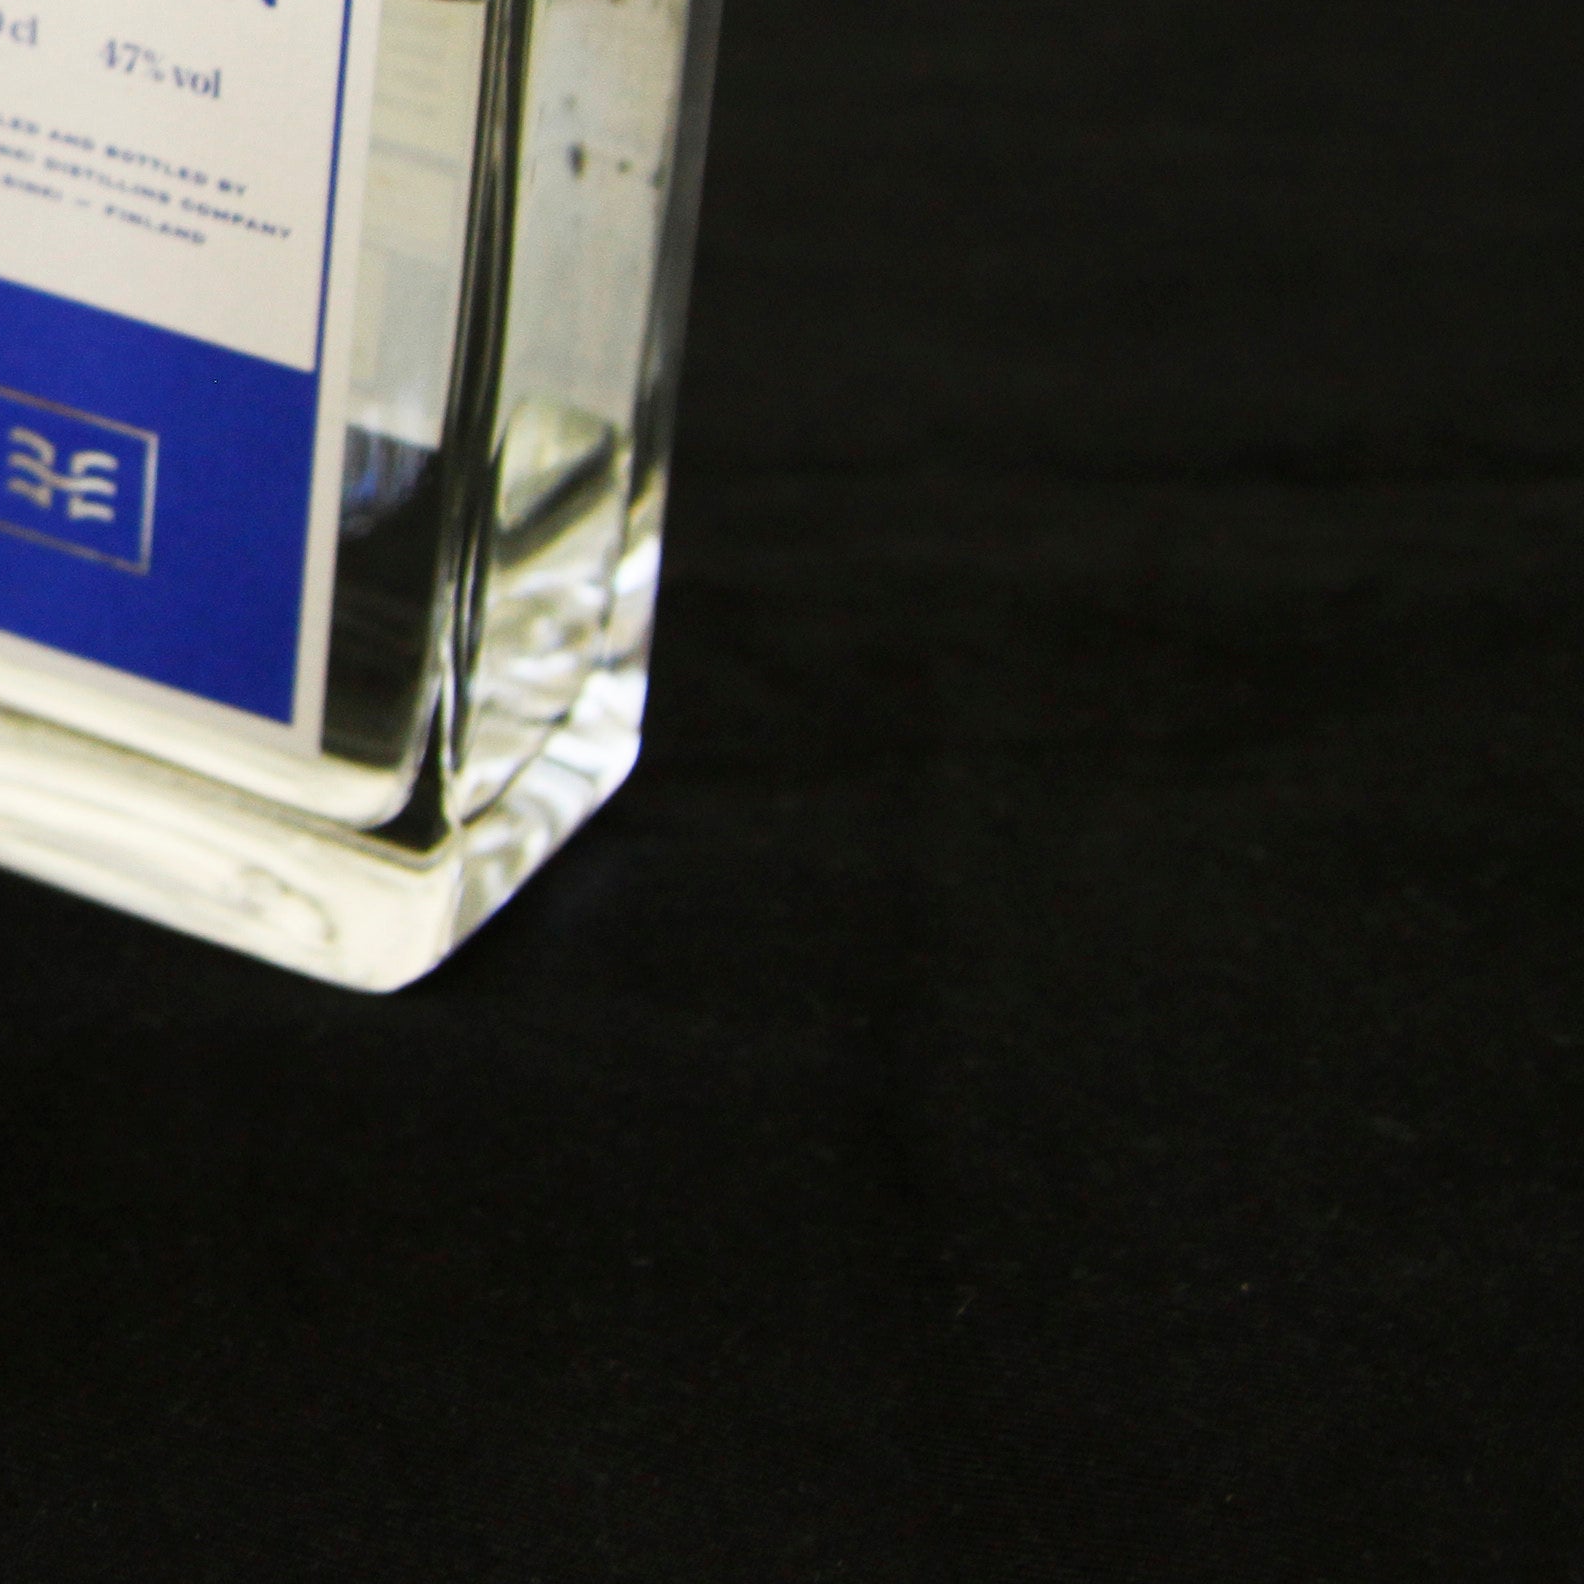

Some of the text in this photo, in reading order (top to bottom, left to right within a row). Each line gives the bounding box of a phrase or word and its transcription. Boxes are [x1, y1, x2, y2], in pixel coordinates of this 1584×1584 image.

[43, 155, 172, 205] DISTILLING
[179, 195, 293, 239] COMPANY
[48, 128, 96, 152] AND
[104, 143, 209, 187] BOTTLED
[216, 178, 248, 197] BY
[103, 203, 207, 246] FINLAND
